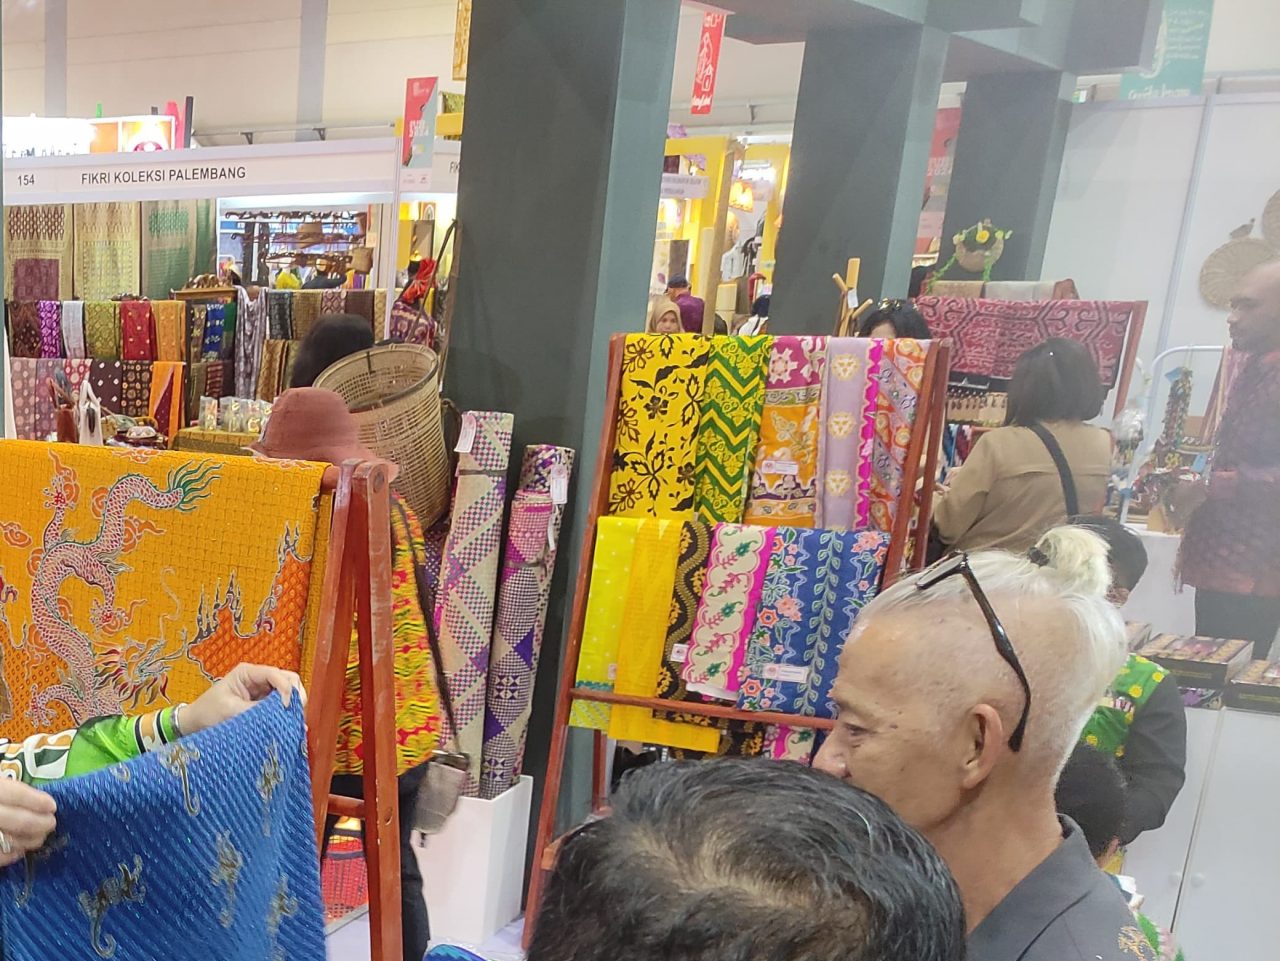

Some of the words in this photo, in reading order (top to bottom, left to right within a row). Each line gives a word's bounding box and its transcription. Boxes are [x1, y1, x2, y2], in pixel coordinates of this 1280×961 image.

[18, 174, 35, 187] 154
[81, 172, 111, 185] FIKRI
[114, 170, 165, 183] KOLEKSI
[169, 166, 246, 181] PALEMBANG
